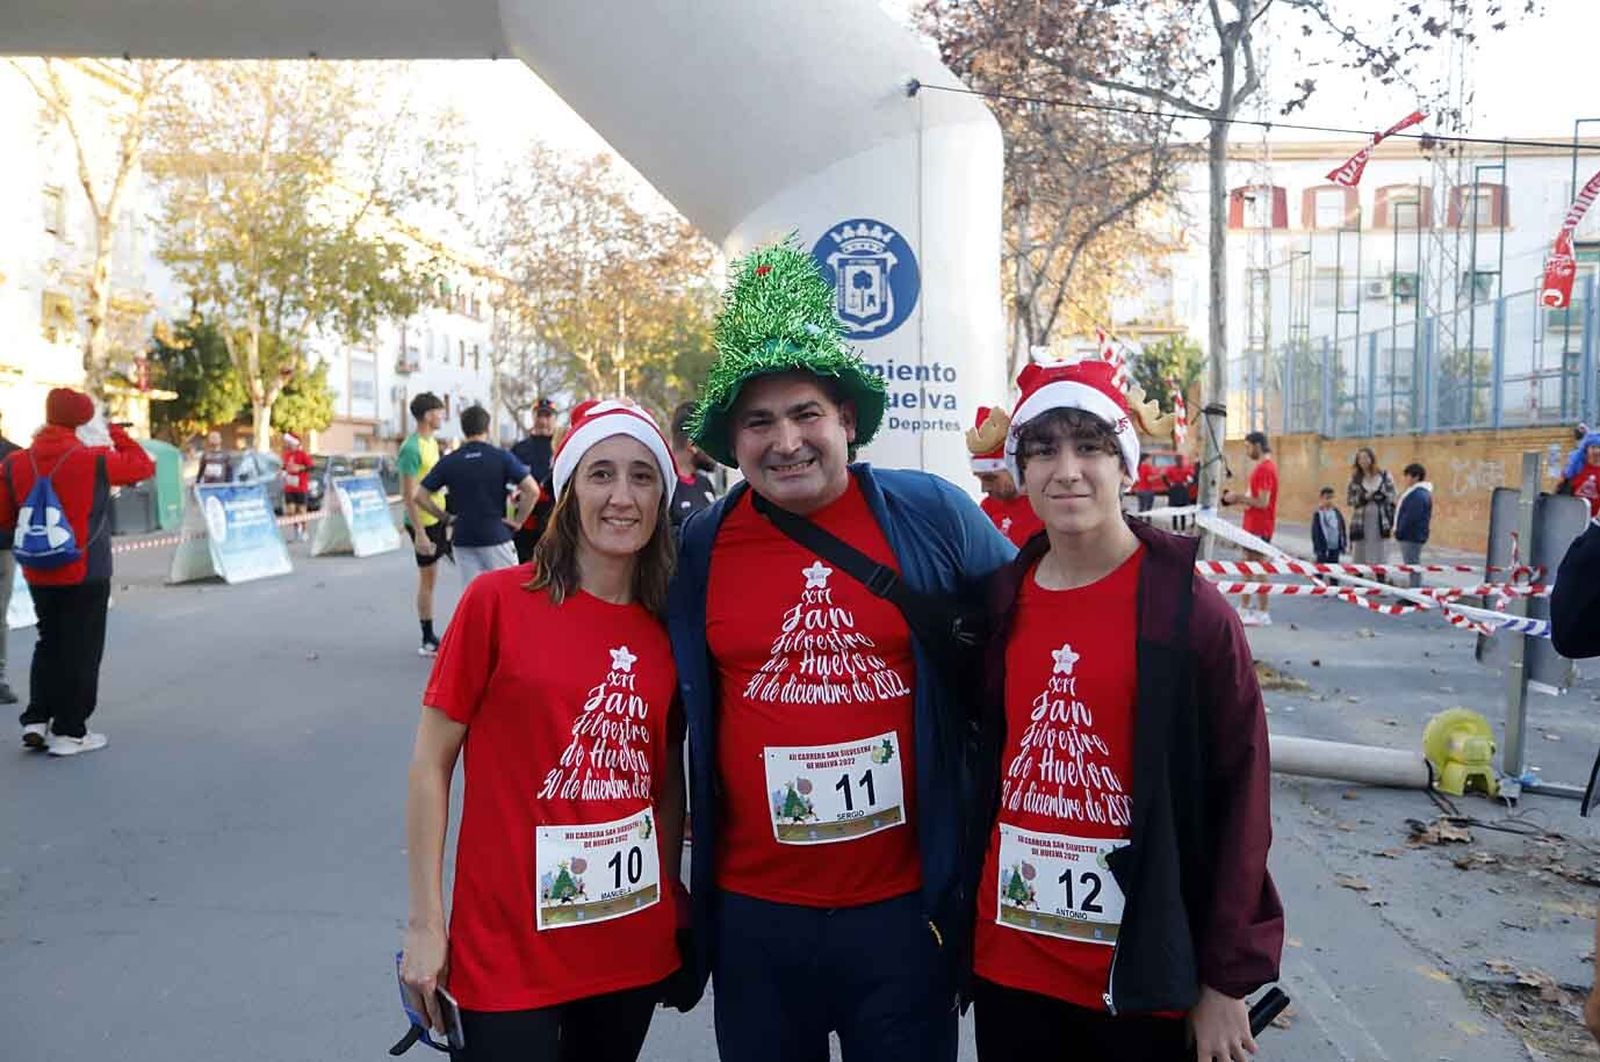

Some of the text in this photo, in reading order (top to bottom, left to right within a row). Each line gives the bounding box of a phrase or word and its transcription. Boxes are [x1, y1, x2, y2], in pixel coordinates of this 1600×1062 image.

[862, 360, 957, 382] miento
[888, 388, 957, 410] uelva
[889, 417, 960, 434] Deportes
[782, 603, 854, 632] San
[760, 649, 886, 676] de Huelva
[760, 672, 781, 702] de
[781, 673, 853, 704] diciembre
[852, 673, 875, 702] de
[867, 669, 910, 700] 2022
[584, 683, 649, 720] San
[1030, 690, 1093, 727] San
[560, 734, 649, 772] de Huelva
[798, 752, 826, 761] CARRERA
[827, 750, 840, 759] SAN
[839, 757, 856, 767] 2022
[1008, 745, 1123, 792] de Huelva
[537, 769, 564, 799] 30
[560, 768, 581, 799] de
[581, 768, 631, 799] diciembre
[836, 769, 876, 811] 11
[837, 809, 864, 820] SERGIO
[1023, 781, 1084, 821] diciembre
[1086, 789, 1106, 824] de
[576, 830, 604, 840] CARRERA
[1052, 840, 1065, 850] SAN
[1065, 842, 1098, 854] SILVESTRE
[608, 846, 643, 889] 10
[1040, 849, 1063, 859] HUELVA
[1064, 852, 1080, 861] 2022
[1058, 868, 1103, 914] 12
[1056, 907, 1088, 920] ANTONIO
